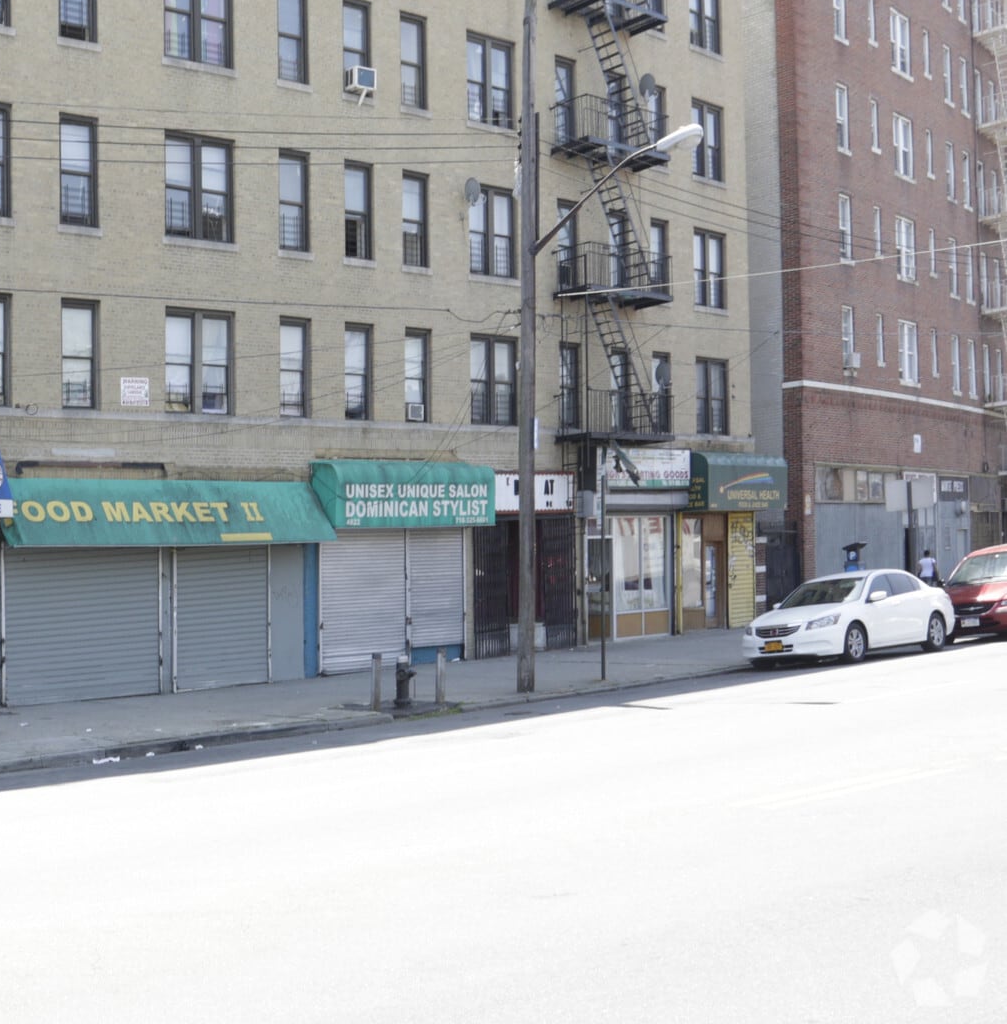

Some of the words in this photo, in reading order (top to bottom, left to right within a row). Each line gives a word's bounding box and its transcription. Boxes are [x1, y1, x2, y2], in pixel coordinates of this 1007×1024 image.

[345, 484, 393, 498] UNISEX
[397, 484, 445, 499] UNIQUE
[448, 484, 487, 498] SALON
[727, 490, 758, 500] UNIVERSAL
[759, 490, 780, 500] HEALTH
[101, 501, 229, 523] MARKET
[241, 502, 265, 522] II
[345, 500, 428, 517] DOMINICAN
[432, 500, 488, 517] STYLIST
